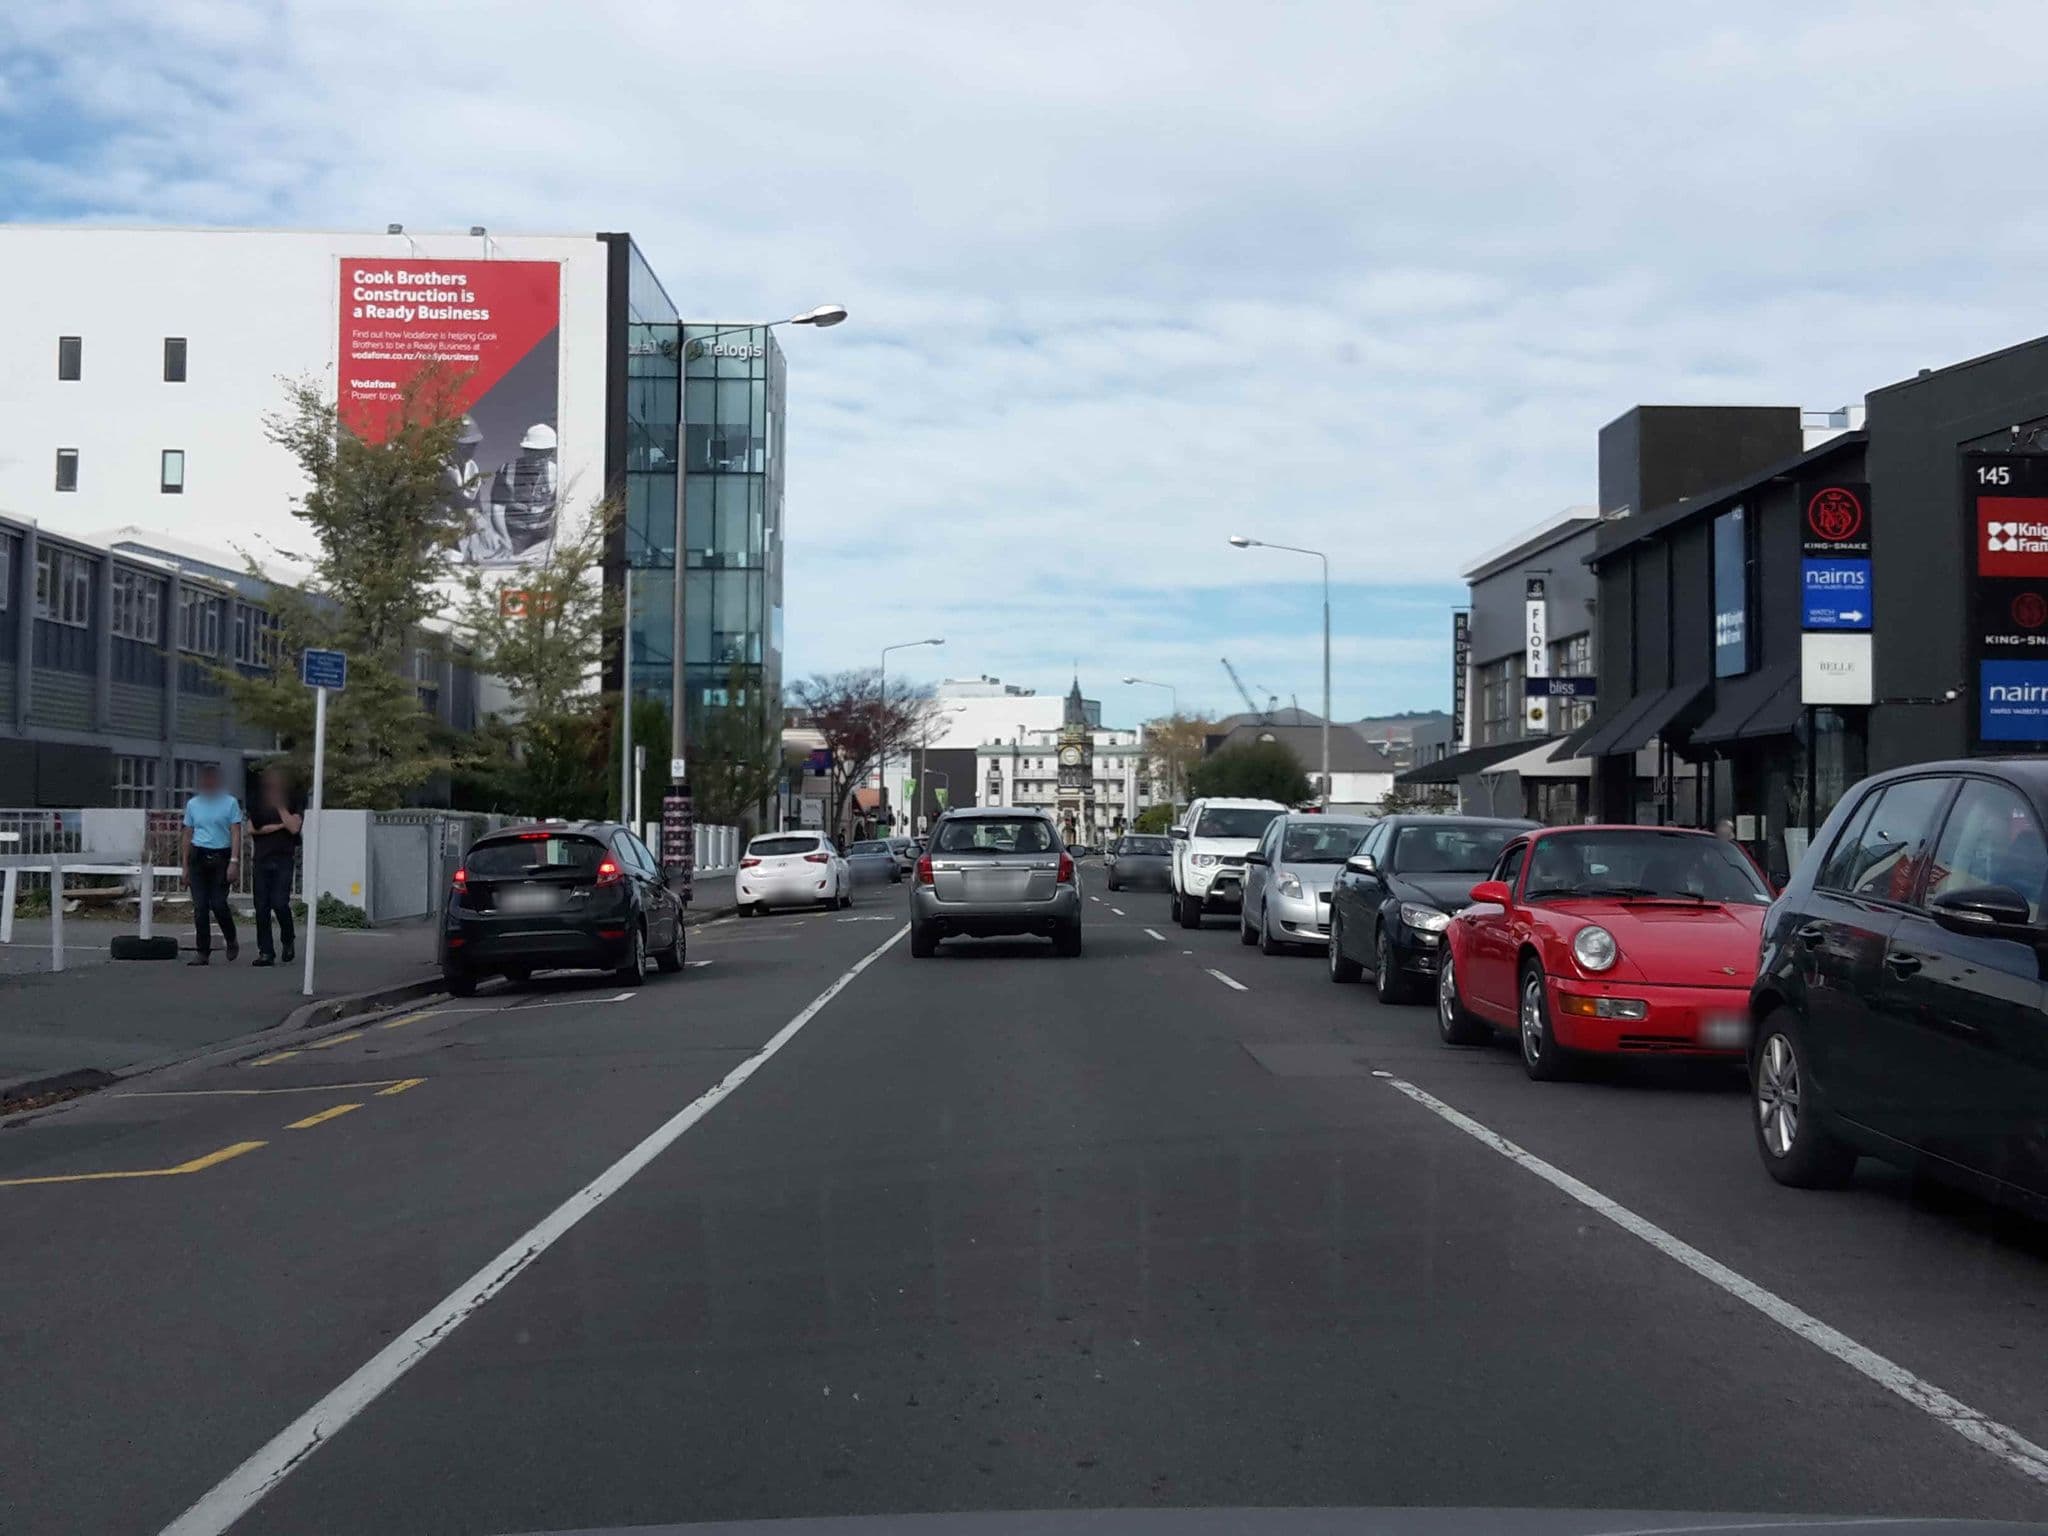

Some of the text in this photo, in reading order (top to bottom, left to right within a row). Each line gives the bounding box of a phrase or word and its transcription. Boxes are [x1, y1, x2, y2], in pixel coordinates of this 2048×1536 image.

[353, 270, 467, 286] Cook Brothers
[353, 287, 475, 303] Construction is
[353, 305, 490, 322] a Ready Business
[352, 330, 369, 339] Find
[403, 331, 440, 340] Vodafone
[448, 331, 476, 342] helping
[478, 331, 497, 341] Cook
[352, 341, 384, 350] Brothers
[413, 342, 437, 351] Ready
[438, 342, 472, 351] Business
[707, 342, 763, 361] Telogis
[351, 380, 396, 389] Vodafone
[351, 391, 377, 400] Power
[1977, 466, 2010, 485] 145
[1806, 568, 1864, 584] nairns
[1550, 681, 1574, 694] bliss
